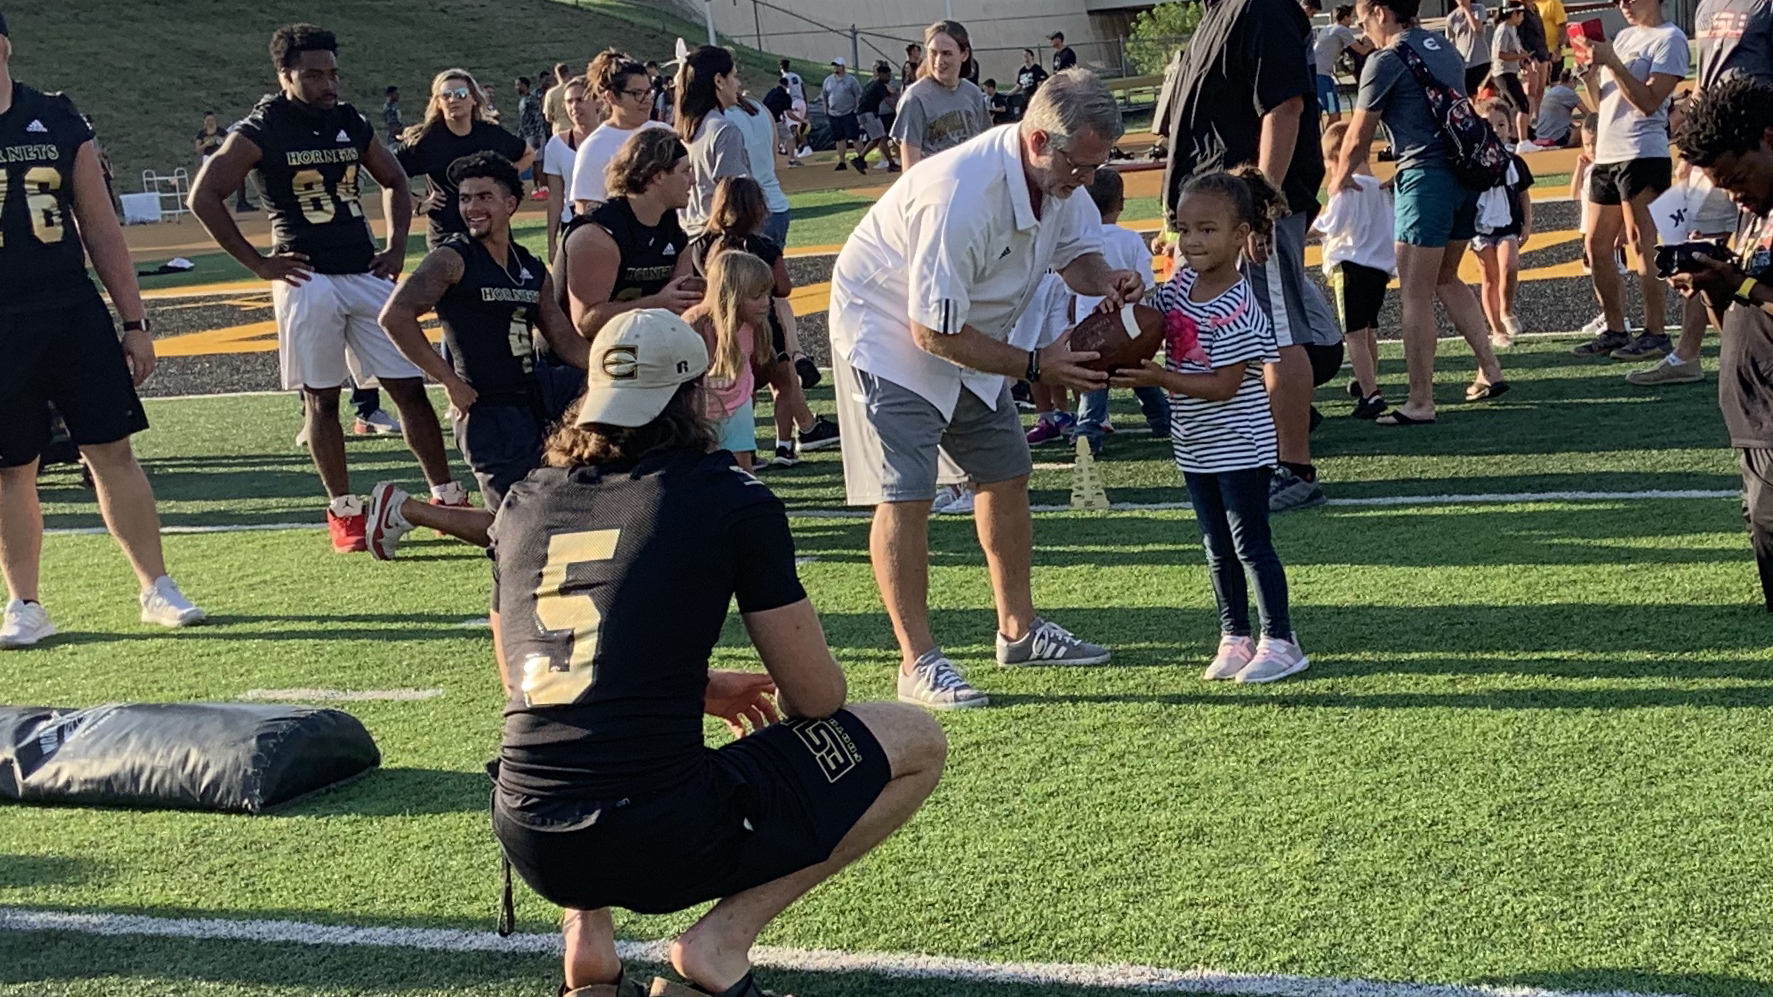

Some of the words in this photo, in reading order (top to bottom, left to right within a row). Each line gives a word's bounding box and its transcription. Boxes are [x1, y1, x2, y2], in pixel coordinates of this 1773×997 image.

[286, 147, 359, 166] HORNETS
[292, 165, 363, 224] 84
[521, 528, 621, 708] 5
